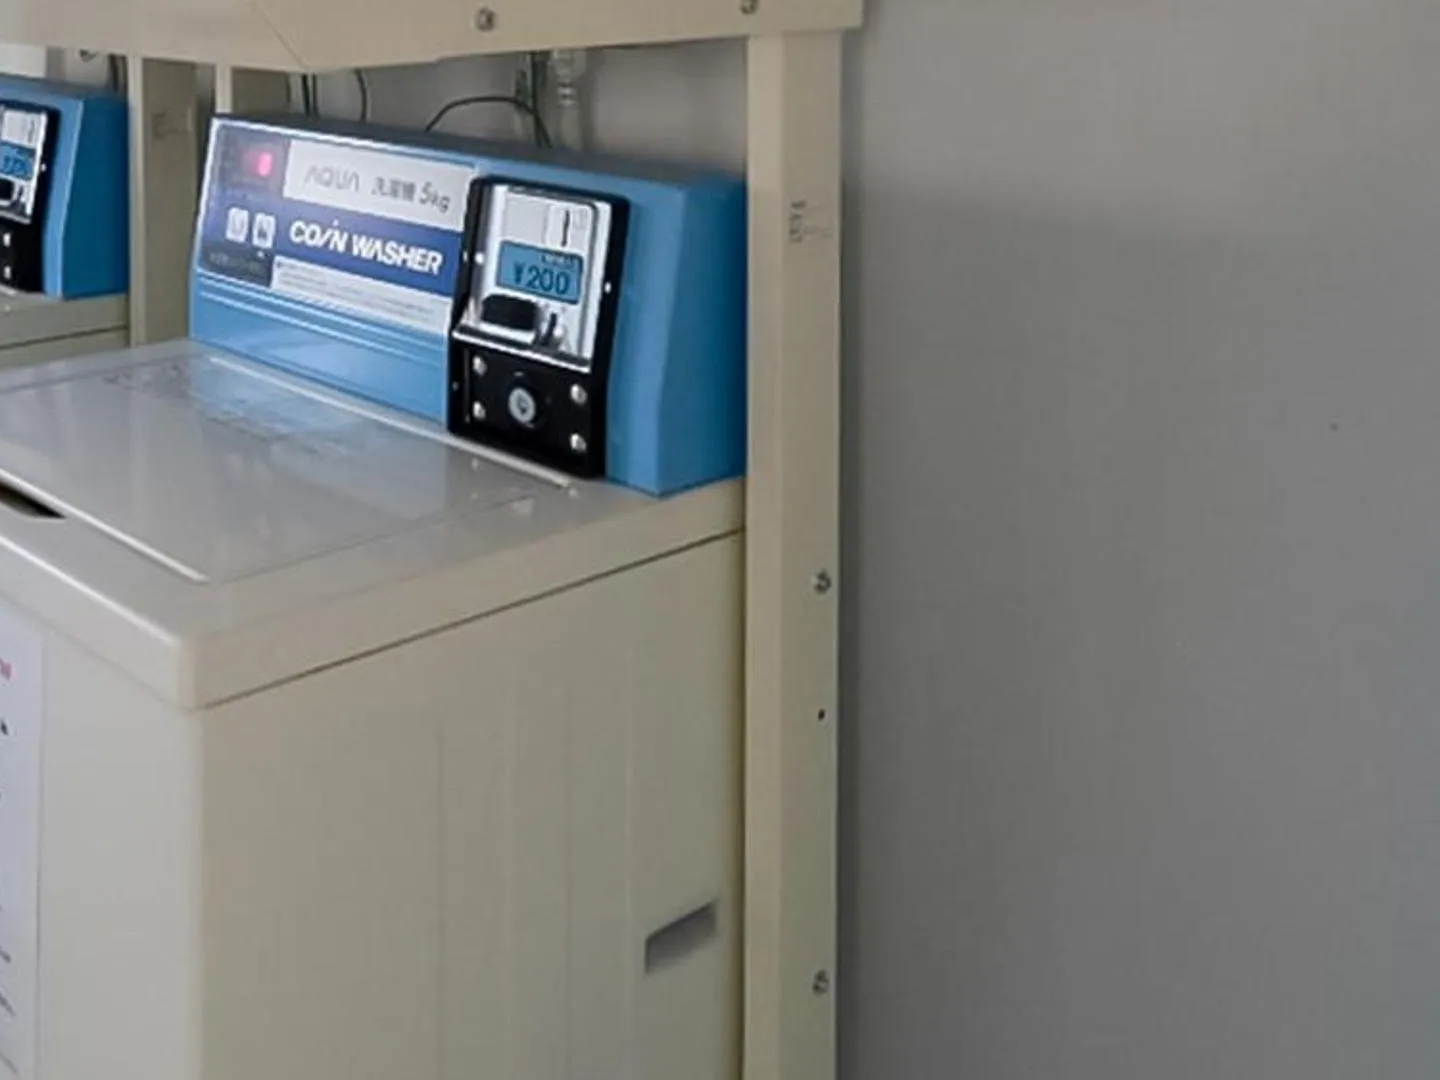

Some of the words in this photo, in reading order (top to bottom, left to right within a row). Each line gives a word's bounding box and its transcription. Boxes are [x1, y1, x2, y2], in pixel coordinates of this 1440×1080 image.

[303, 165, 360, 193] AQUA
[289, 219, 348, 253] COIN
[351, 235, 444, 276] WASHER
[513, 261, 571, 295] ¥200
